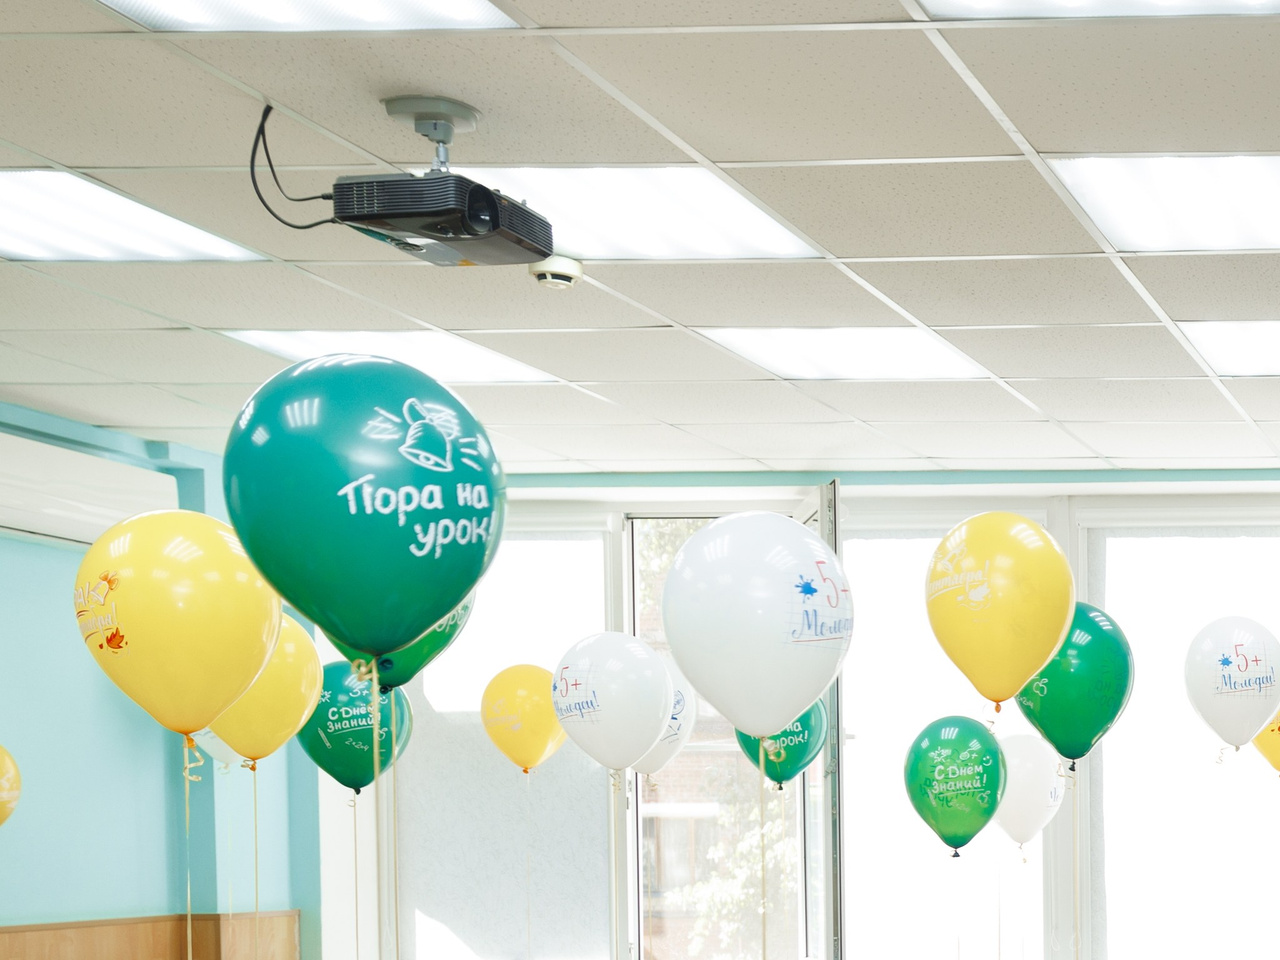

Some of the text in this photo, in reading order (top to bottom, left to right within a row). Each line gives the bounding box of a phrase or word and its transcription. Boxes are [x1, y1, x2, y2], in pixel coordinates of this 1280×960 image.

[337, 474, 490, 527] Пора на
[409, 510, 495, 559] урок!
[1235, 644, 1262, 672] 5+
[560, 666, 582, 698] 5+
[328, 707, 339, 720] С
[932, 773, 987, 793] Знаний!
[934, 762, 983, 780] С Днём
